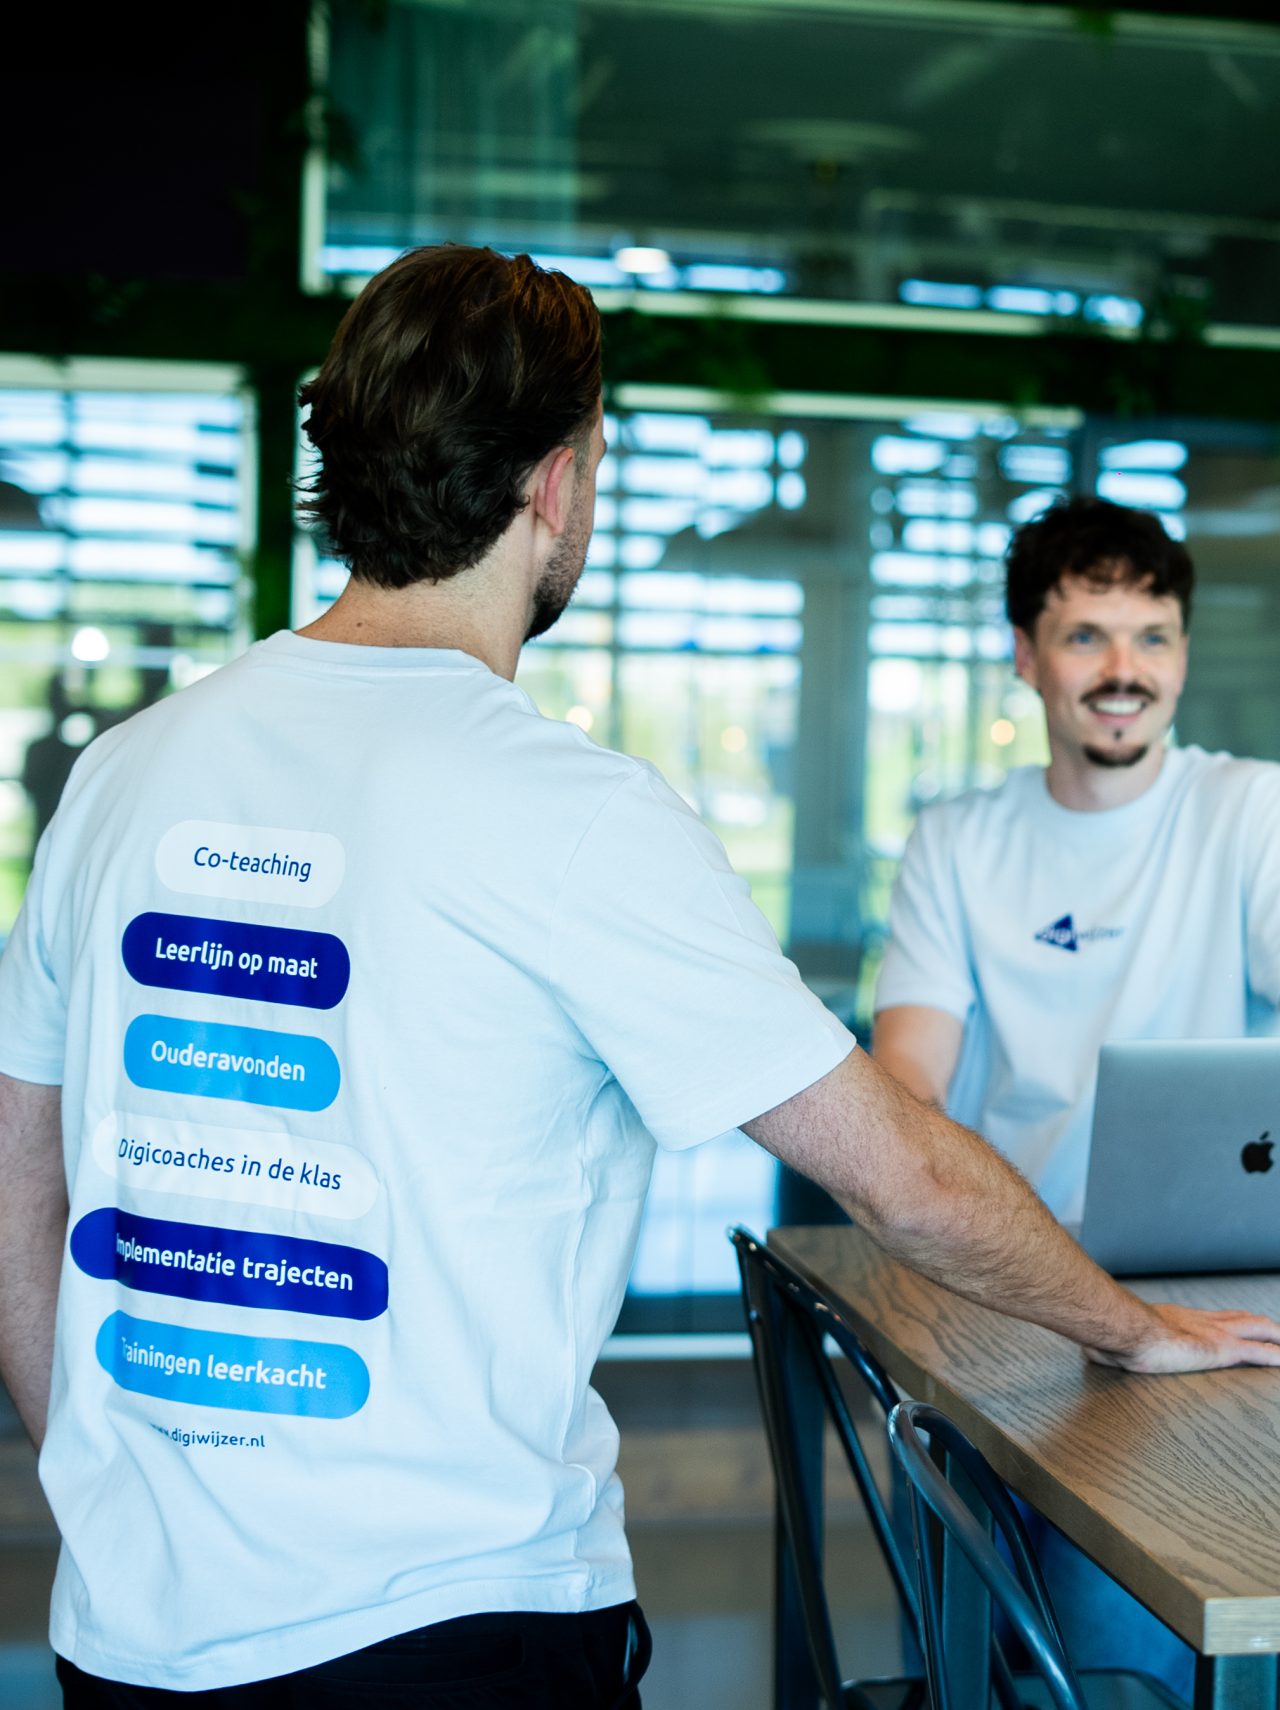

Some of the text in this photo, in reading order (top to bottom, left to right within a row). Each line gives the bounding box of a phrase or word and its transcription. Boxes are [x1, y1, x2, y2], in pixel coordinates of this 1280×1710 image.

[193, 847, 311, 882] Co-teaching
[155, 937, 318, 979] Leerlijn op maat
[151, 1040, 306, 1082] Ouderavonden
[118, 1138, 342, 1190] Digicoaches in de klas
[242, 1257, 353, 1291] trajecten
[207, 1354, 327, 1389] leerkacht
[149, 1422, 265, 1447] .digiwijzer.nl
